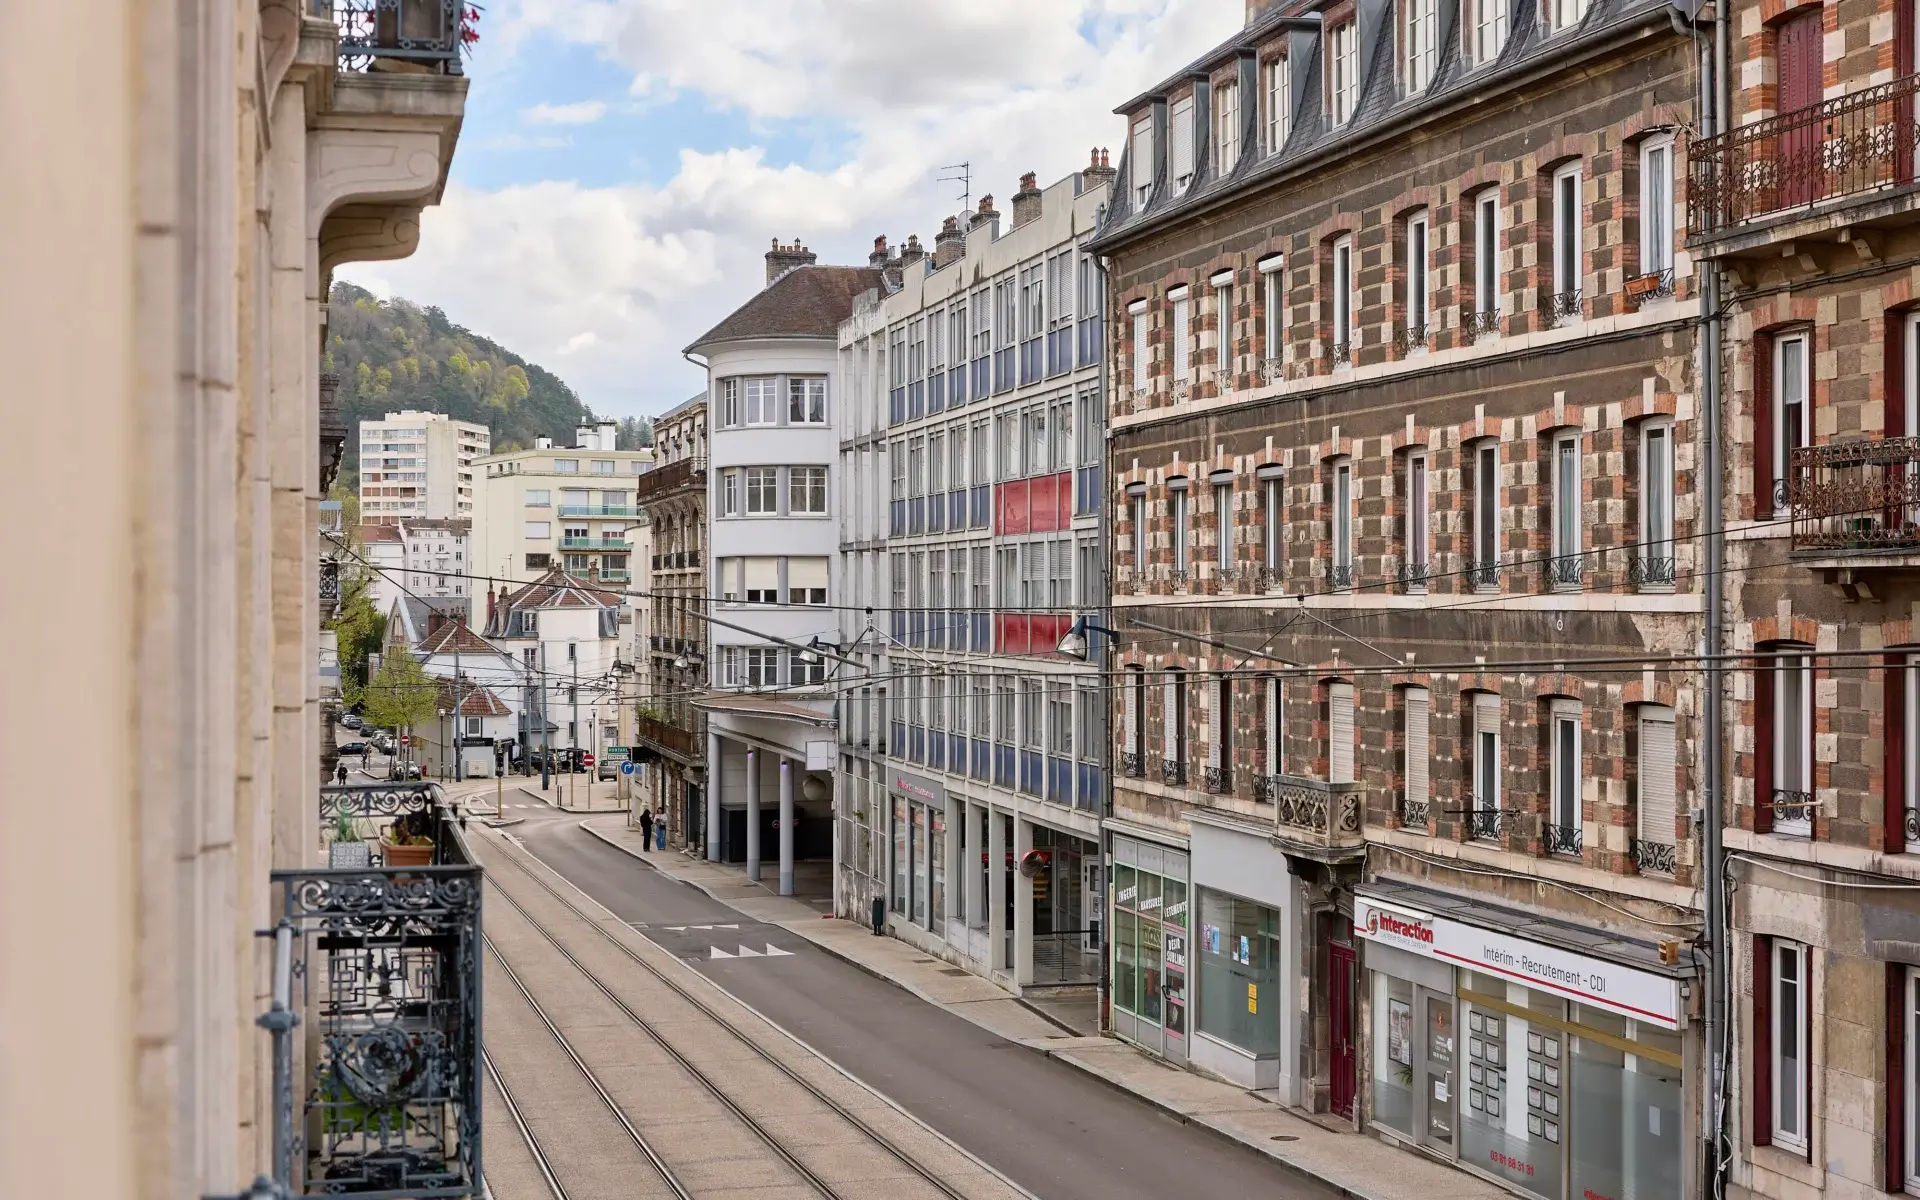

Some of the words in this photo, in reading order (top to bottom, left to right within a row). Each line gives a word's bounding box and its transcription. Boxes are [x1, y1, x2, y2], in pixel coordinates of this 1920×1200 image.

[1116, 885, 1136, 903] LINGERIE
[1380, 912, 1434, 944] Interaction
[1167, 950, 1185, 967] SUBLIME
[1483, 944, 1514, 966] Intérim
[1522, 955, 1581, 986] Recrutement
[1590, 974, 1606, 993] CDI
[1490, 1150, 1498, 1162] 03
